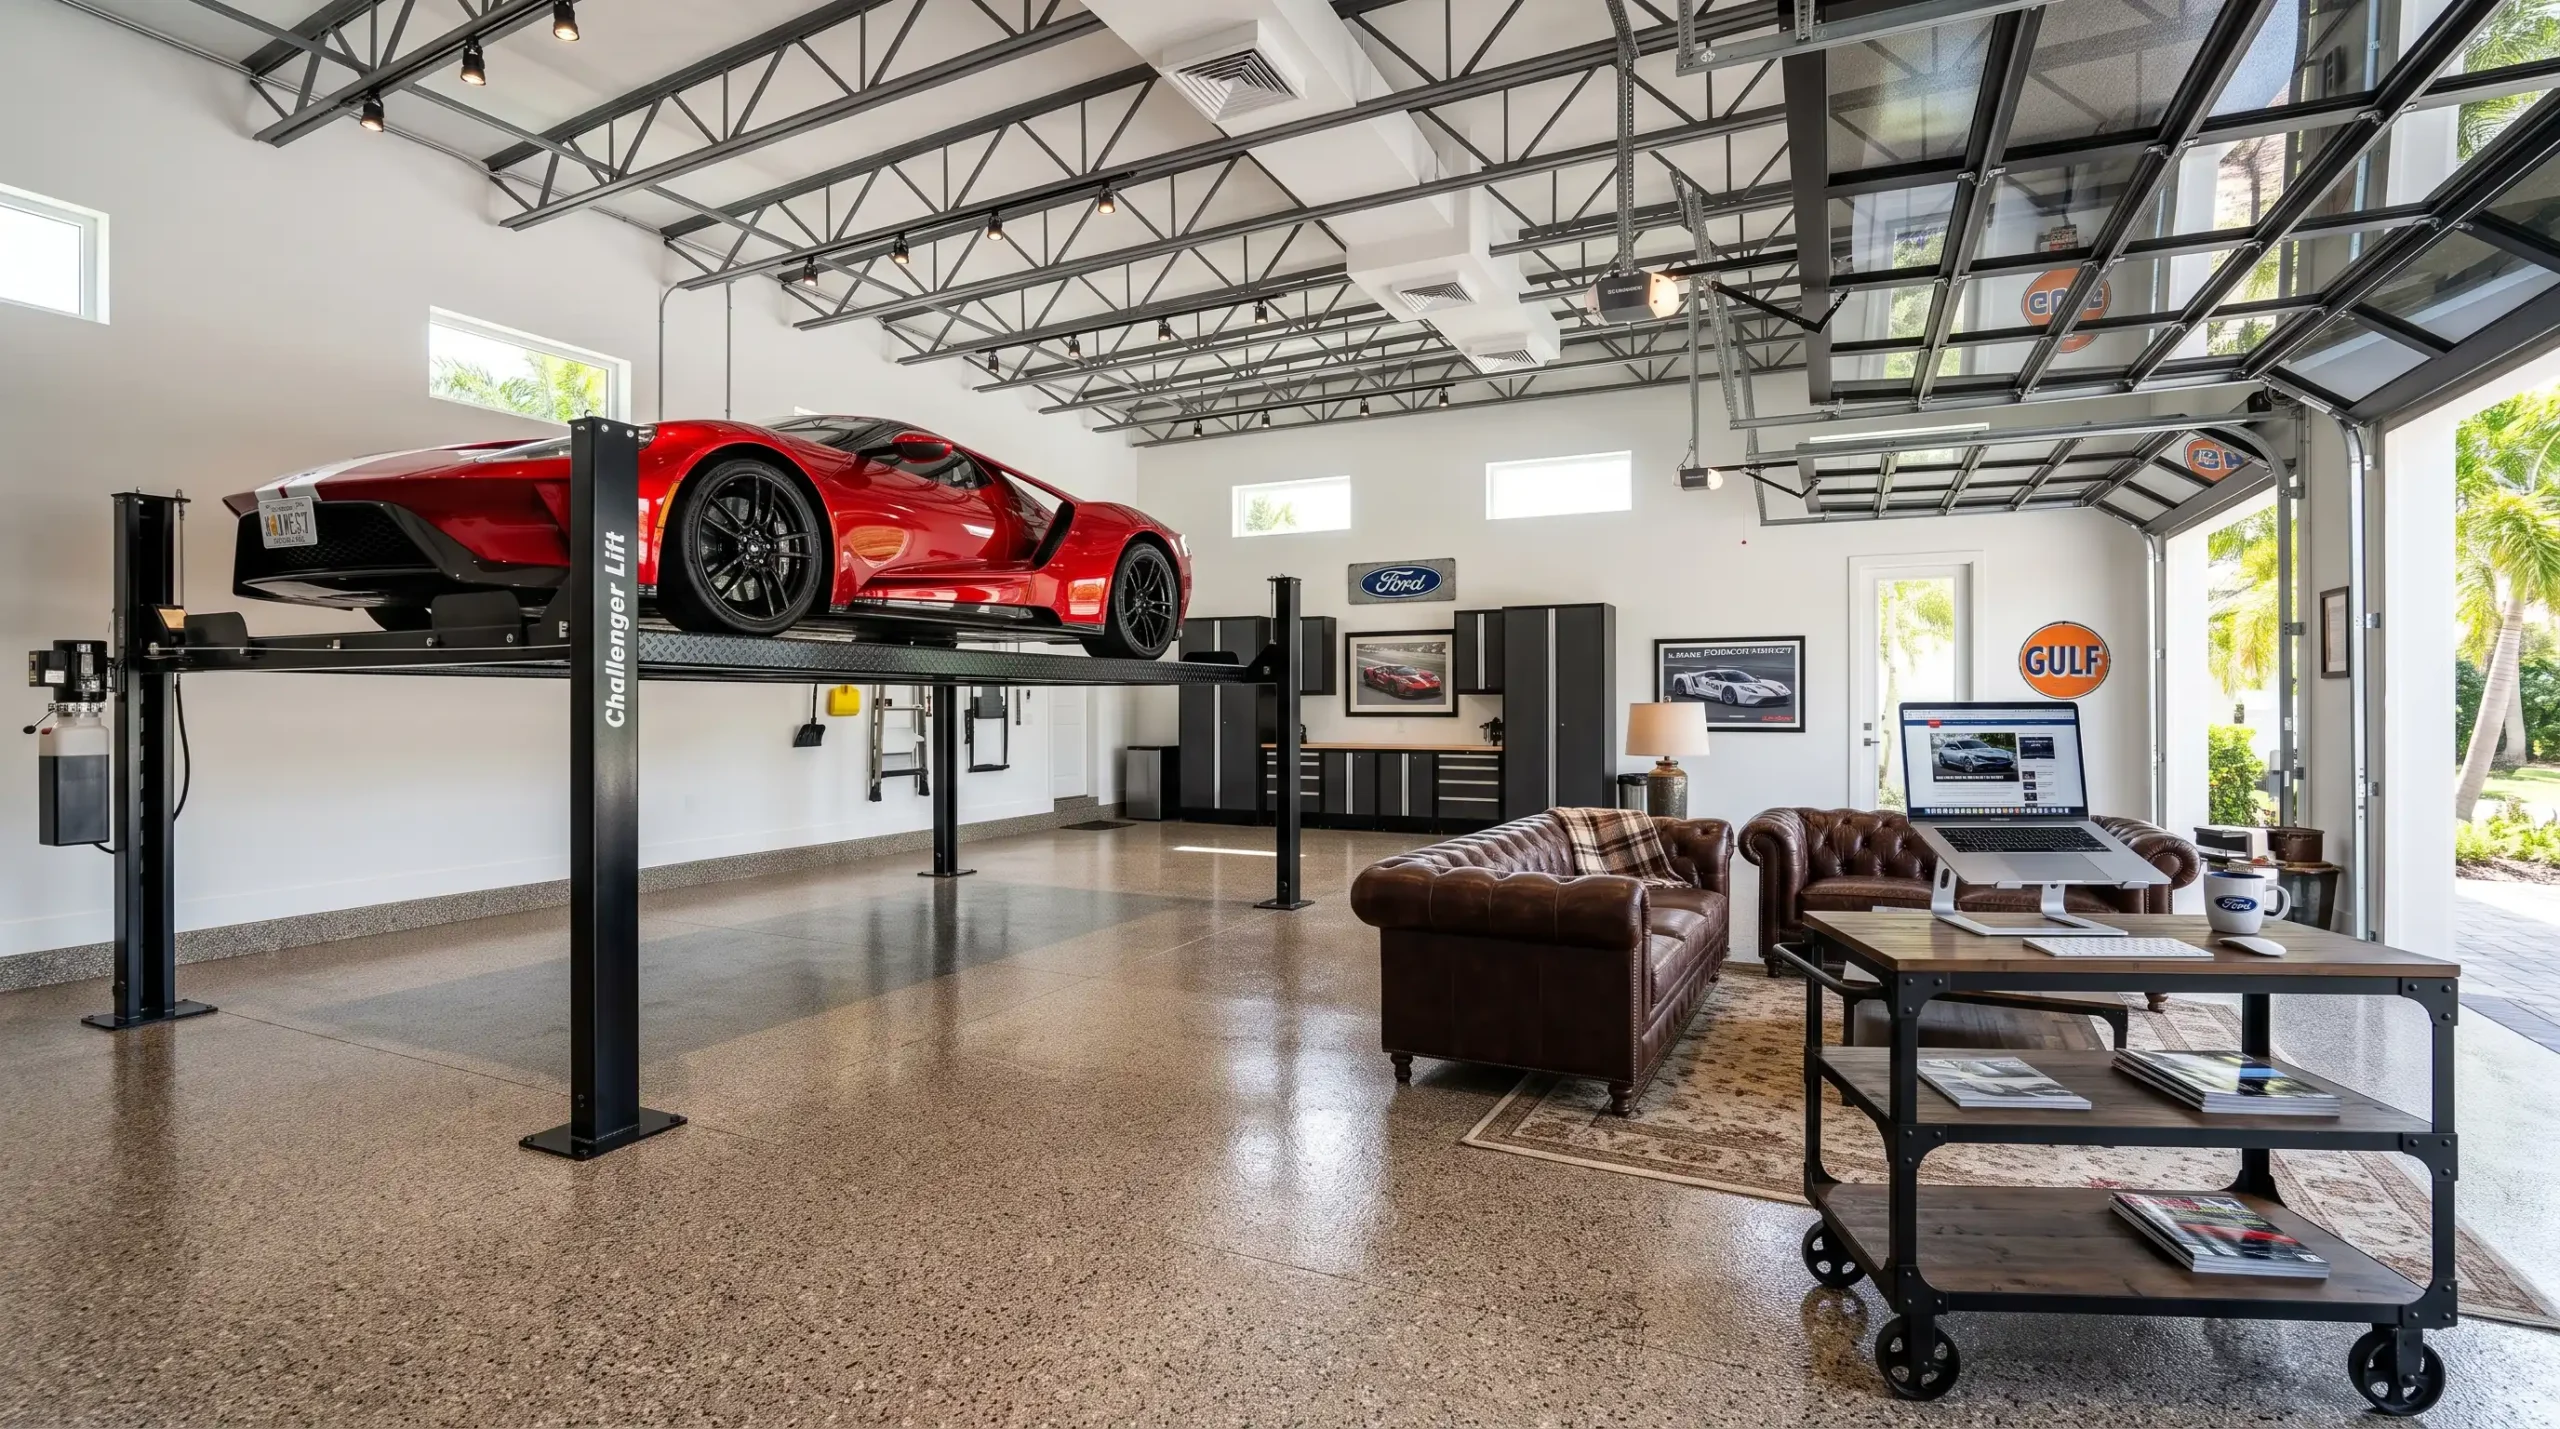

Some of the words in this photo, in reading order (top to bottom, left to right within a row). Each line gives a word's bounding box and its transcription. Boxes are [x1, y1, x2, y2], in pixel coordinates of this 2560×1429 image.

[605, 531, 625, 577] Lift
[1375, 570, 1427, 593] Ford
[605, 582, 630, 728] Challenger
[2025, 645, 2102, 677] GULF
